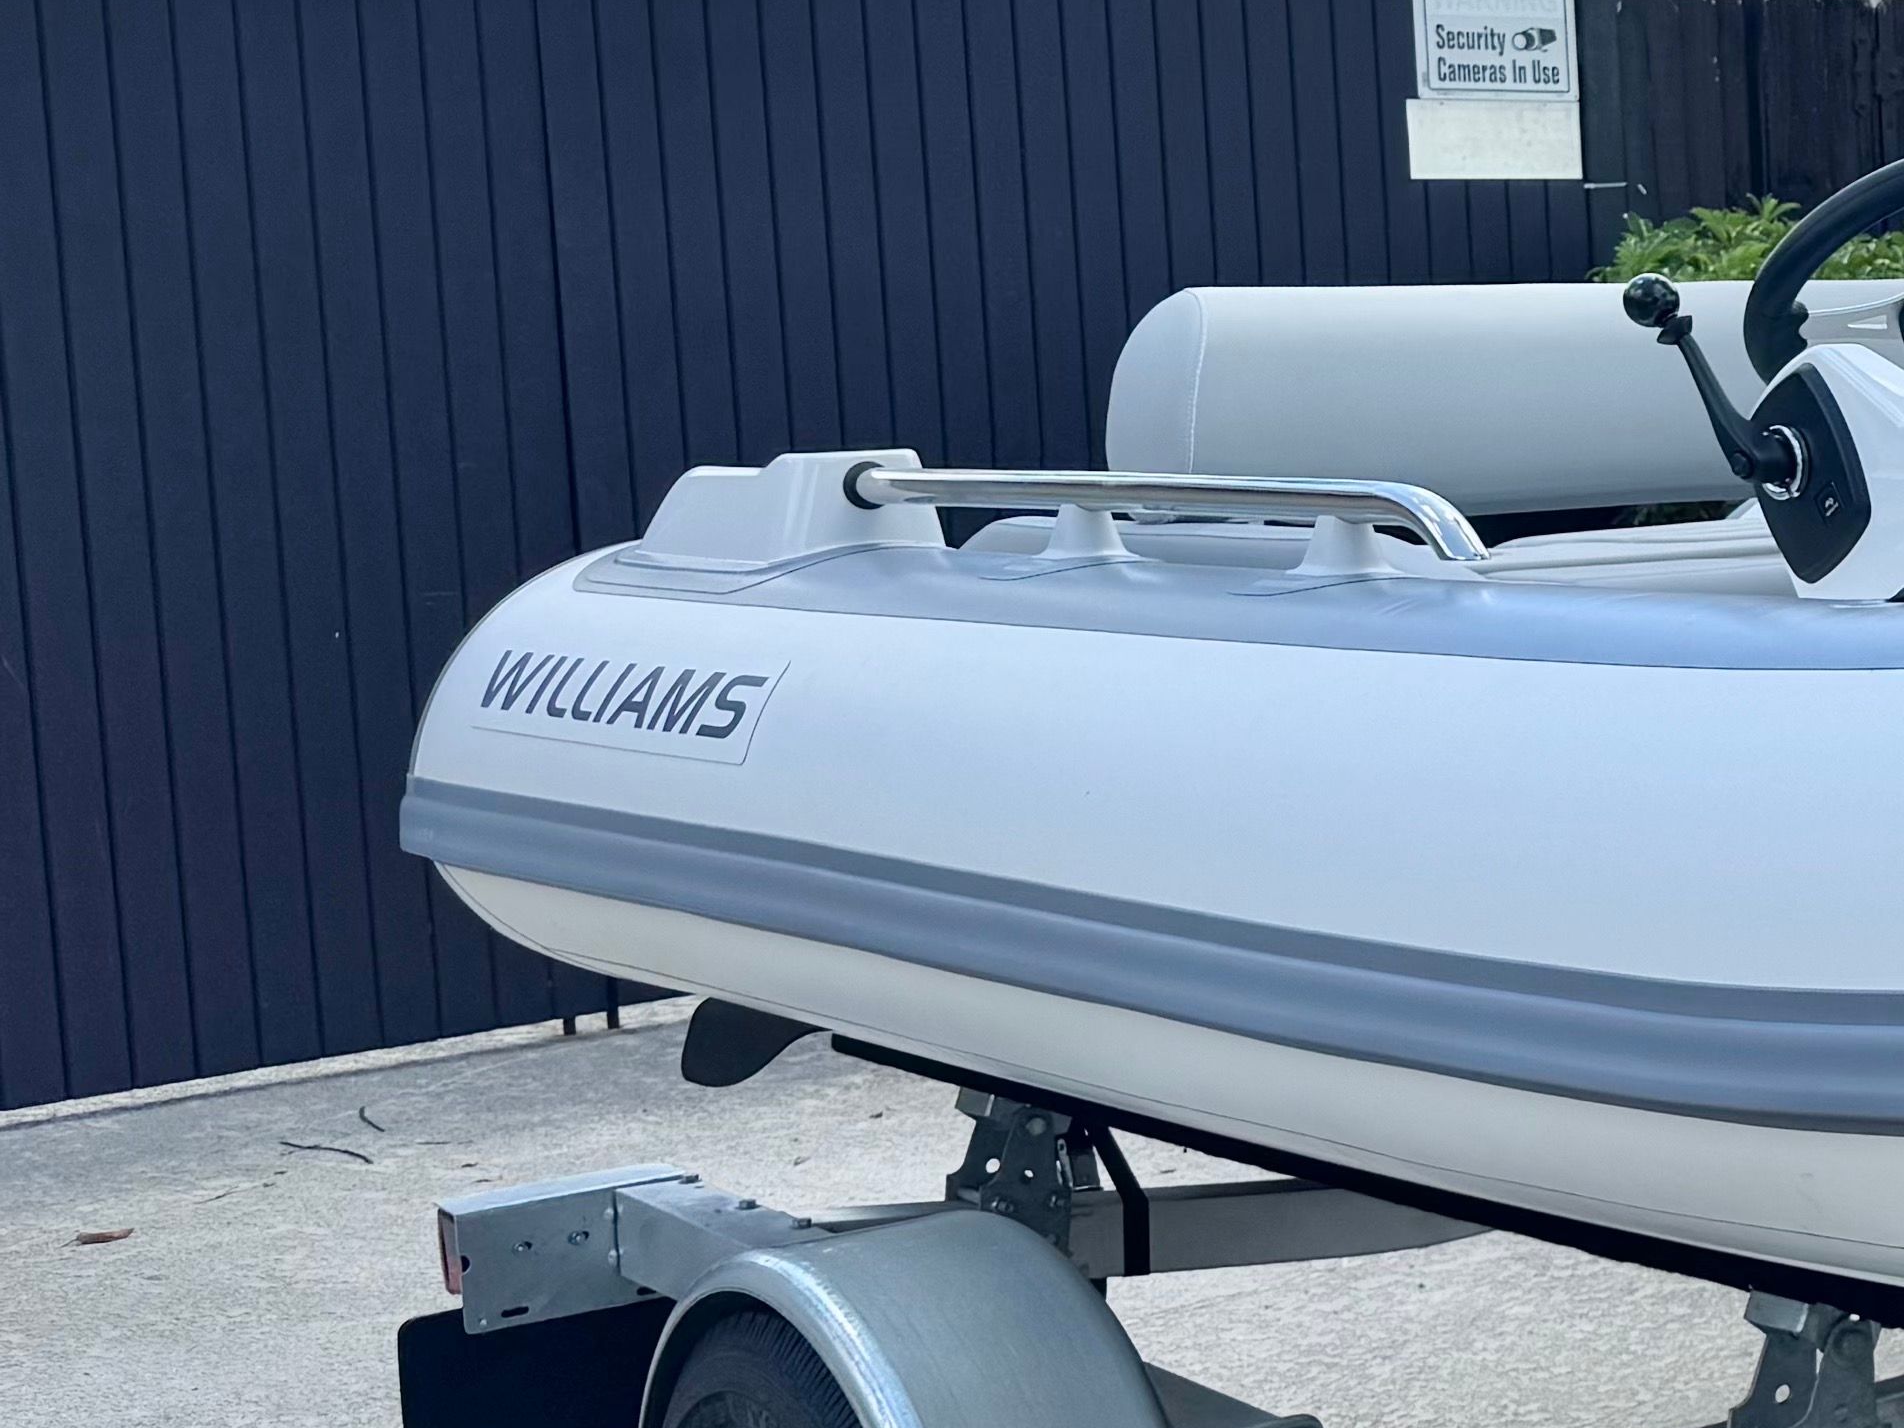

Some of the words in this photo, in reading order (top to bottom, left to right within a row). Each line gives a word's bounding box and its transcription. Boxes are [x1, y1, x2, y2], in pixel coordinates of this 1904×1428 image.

[1435, 23, 1506, 56] Security
[1437, 57, 1507, 83] Cameras
[1512, 59, 1527, 84] In
[1532, 60, 1560, 85] Use
[480, 649, 770, 739] WILLIAMS
